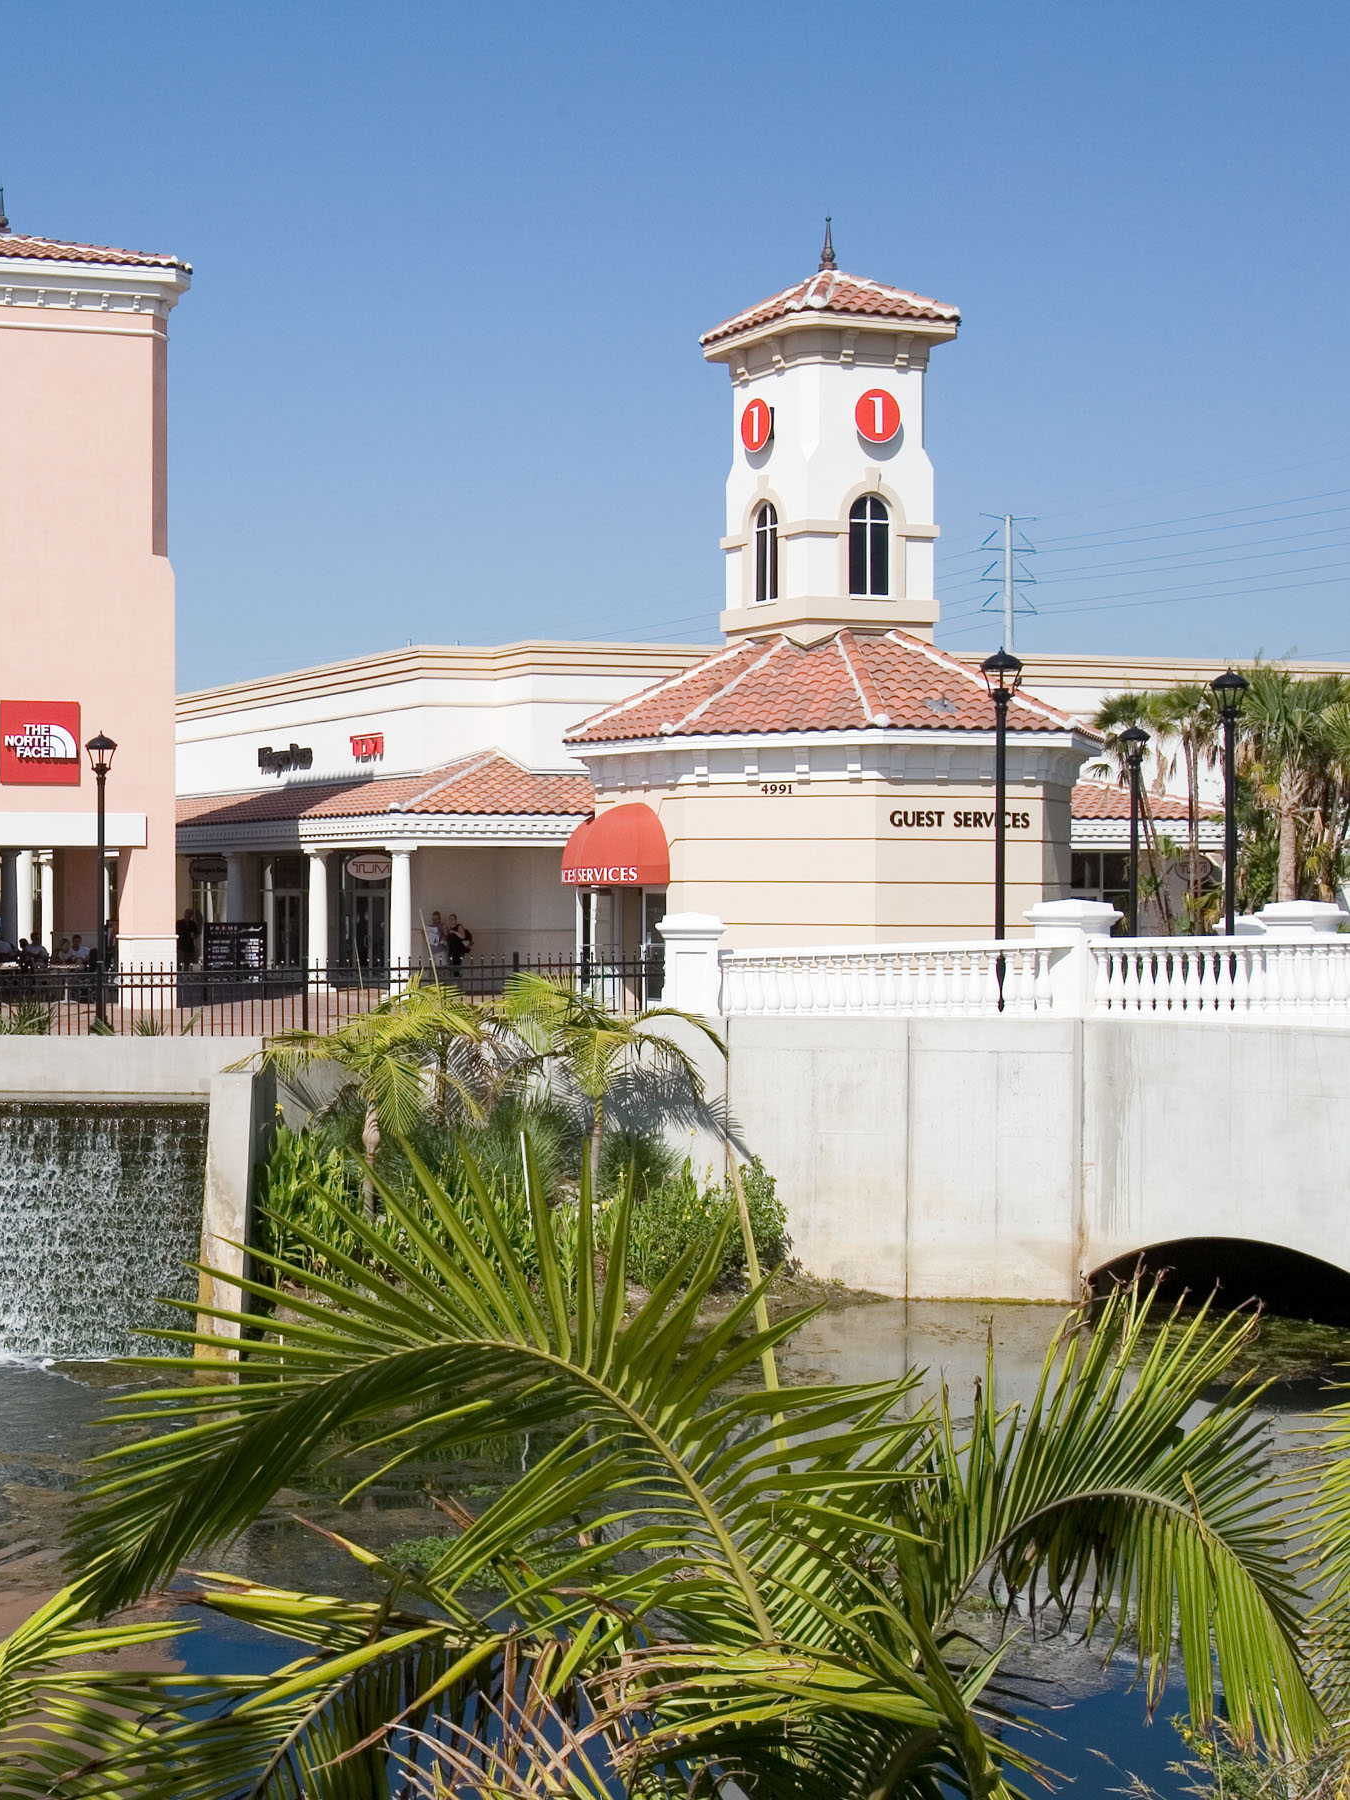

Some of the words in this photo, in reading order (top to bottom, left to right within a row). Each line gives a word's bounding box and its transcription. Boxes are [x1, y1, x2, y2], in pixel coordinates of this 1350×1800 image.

[23, 724, 50, 735] THE
[4, 735, 50, 747] NORTH
[16, 746, 50, 758] FACE
[761, 783, 793, 795] 4991
[889, 810, 945, 828] GUEST
[953, 811, 1030, 829] SERVCES
[577, 866, 638, 882] SERVICES
